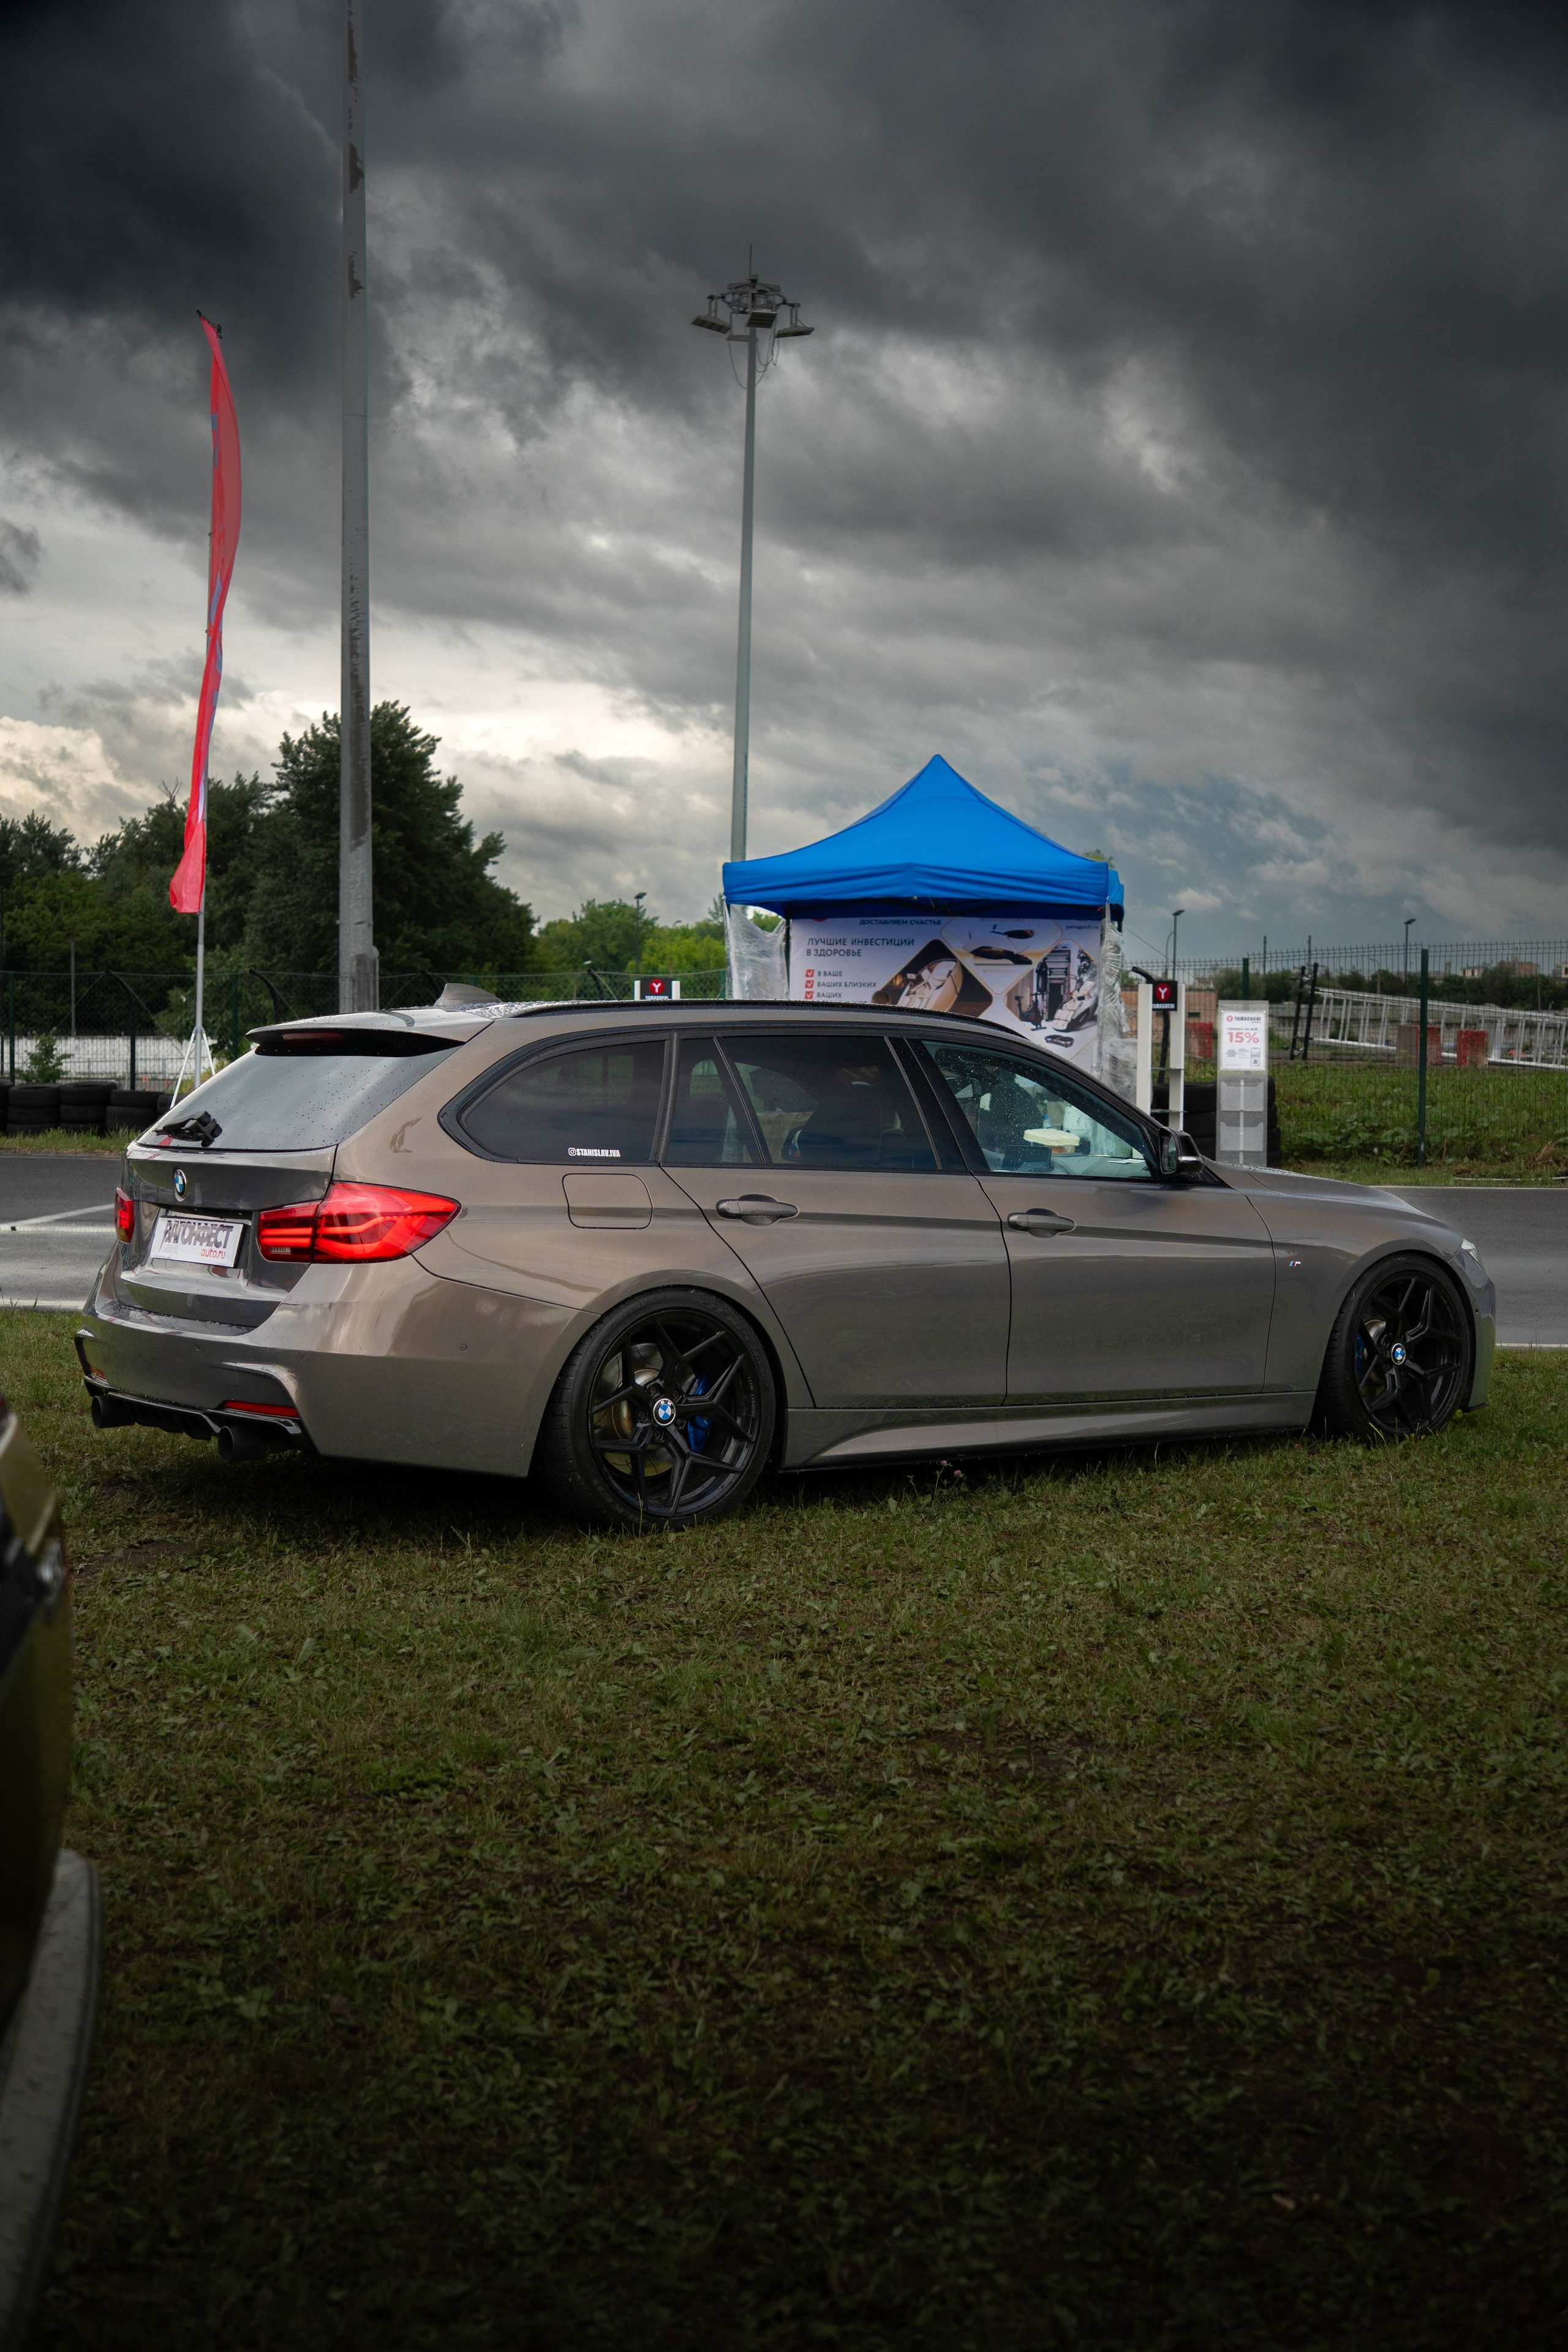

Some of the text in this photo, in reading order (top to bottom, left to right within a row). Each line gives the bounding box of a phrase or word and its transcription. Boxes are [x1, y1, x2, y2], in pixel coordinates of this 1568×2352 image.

[807, 938, 847, 946] ЛУЧШИЕ
[813, 949, 862, 957] ЗДОРОВЬЕ
[1227, 1031, 1259, 1043] 15%
[200, 1248, 226, 1259] auto.ru
